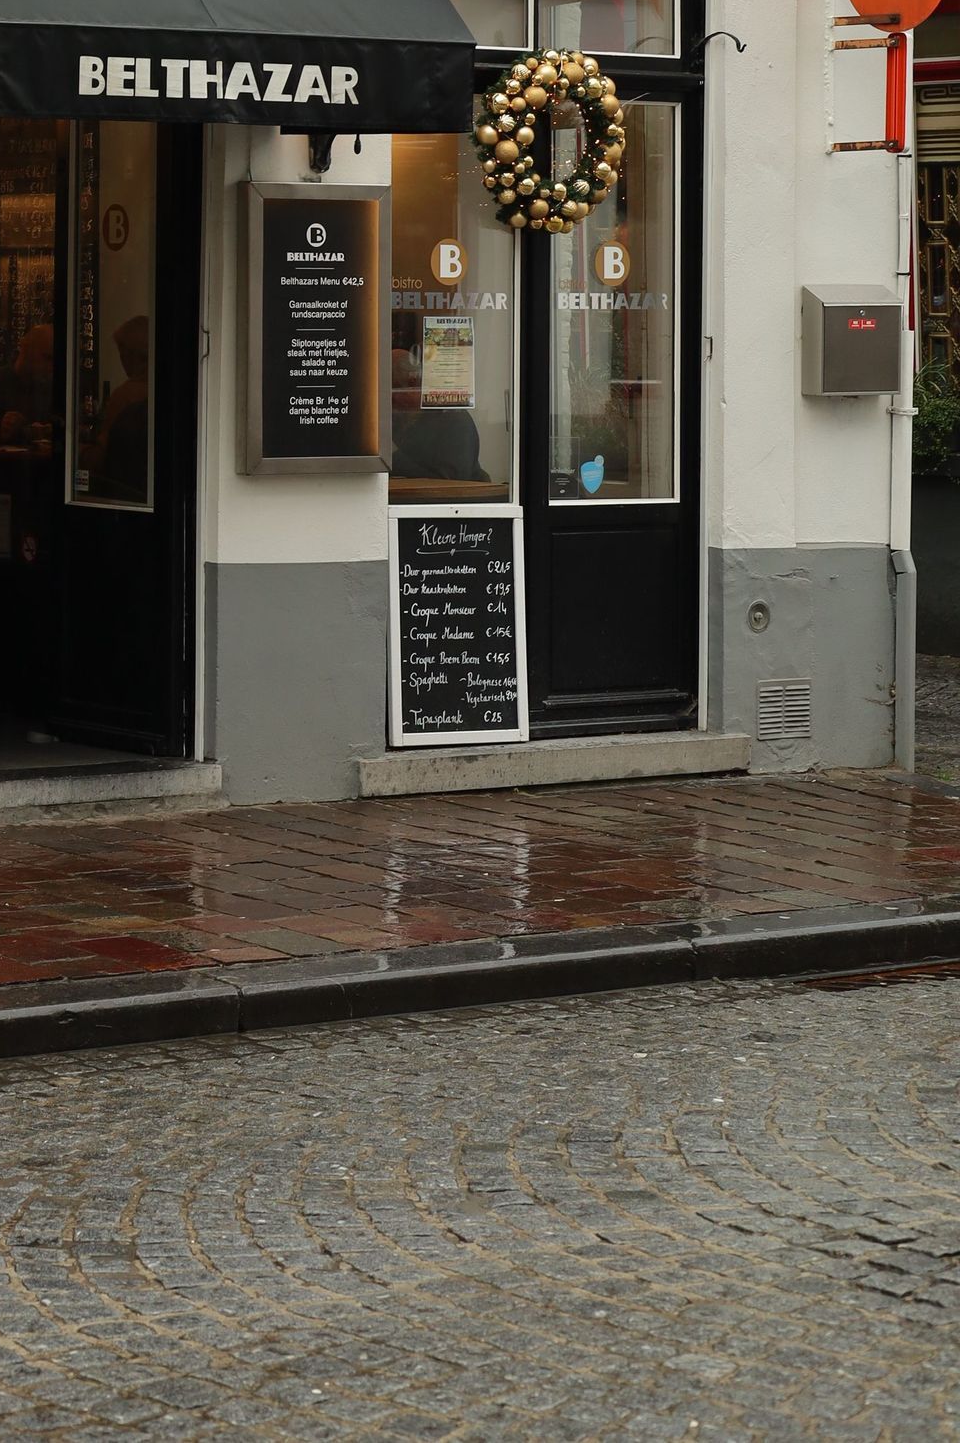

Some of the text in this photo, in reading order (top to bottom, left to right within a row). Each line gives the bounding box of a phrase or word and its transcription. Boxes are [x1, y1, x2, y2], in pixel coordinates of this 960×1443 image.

[79, 55, 359, 105] BELTHAZAR
[310, 227, 325, 244] B
[286, 252, 345, 262] BELTHAZAR
[439, 244, 463, 278] B
[603, 246, 625, 279] B
[280, 276, 364, 287] Belthazars Menu €42,5
[289, 300, 349, 309] Garnaalkroket of
[391, 291, 508, 310] BELTHAZAR
[557, 292, 669, 310] BELTHAZAR
[291, 310, 346, 320] rundscarpaccio
[291, 338, 347, 349] Sliptongetjes of
[287, 348, 350, 358] steak met frietjes,
[301, 358, 337, 367] salade en
[289, 368, 348, 377] saus naar keuze
[289, 396, 314, 406] Crème
[341, 395, 349, 405] of
[289, 405, 349, 415] dame blanche of
[299, 416, 339, 425] Irish coffee
[419, 523, 457, 546] Kleine
[486, 582, 511, 596] €19,5
[410, 602, 440, 627] Croque
[409, 626, 438, 648] Croque
[441, 625, 475, 640] Madame
[409, 652, 436, 672] Croque
[409, 672, 449, 695] Spaghetti
[408, 708, 503, 730] Tapasplank €25
